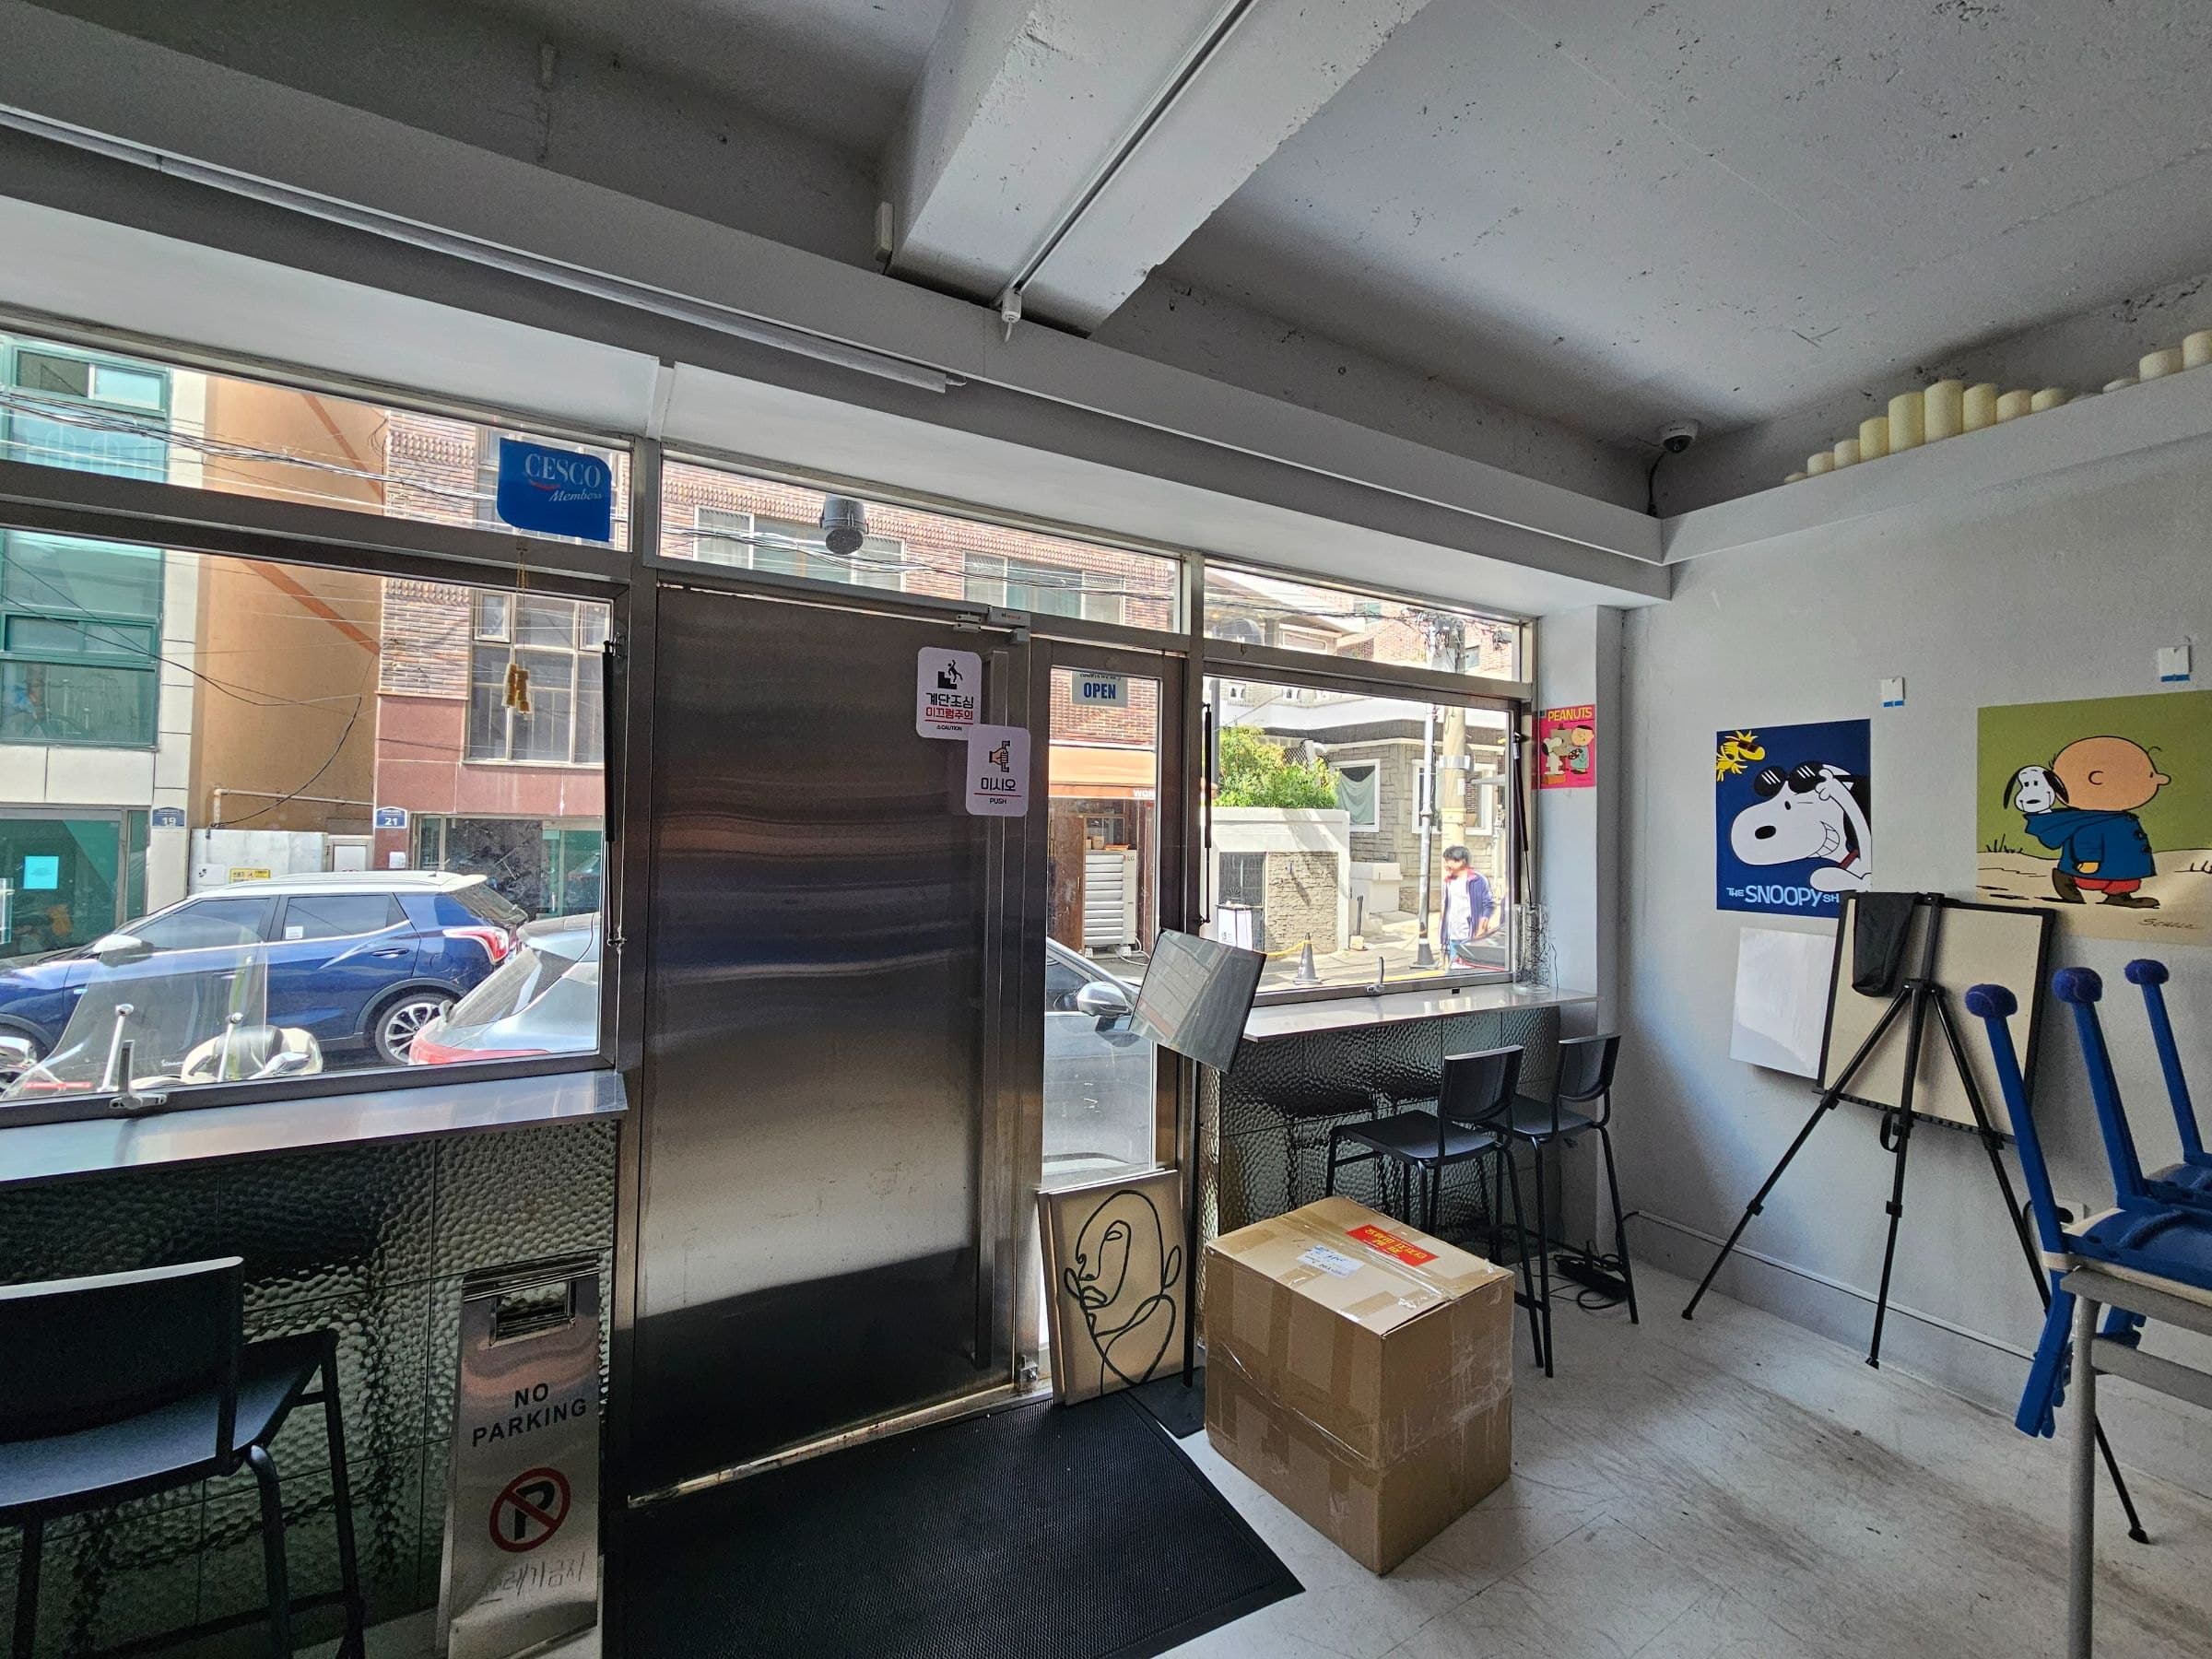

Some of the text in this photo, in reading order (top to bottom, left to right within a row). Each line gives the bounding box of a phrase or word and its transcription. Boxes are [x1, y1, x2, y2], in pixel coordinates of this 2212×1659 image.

[524, 453, 601, 488] CESCO
[1083, 682, 1116, 700] OPEN
[925, 692, 974, 709] 계단조심
[925, 706, 973, 720] 미끄럼주의
[1547, 707, 1593, 722] PEANUTS
[981, 777, 1017, 792] 미시오
[161, 817, 177, 827] 19
[384, 817, 398, 826] 21
[1725, 885, 1840, 908] THE SNOOPY SH
[514, 1382, 549, 1408] NO
[472, 1397, 587, 1447] PARKING
